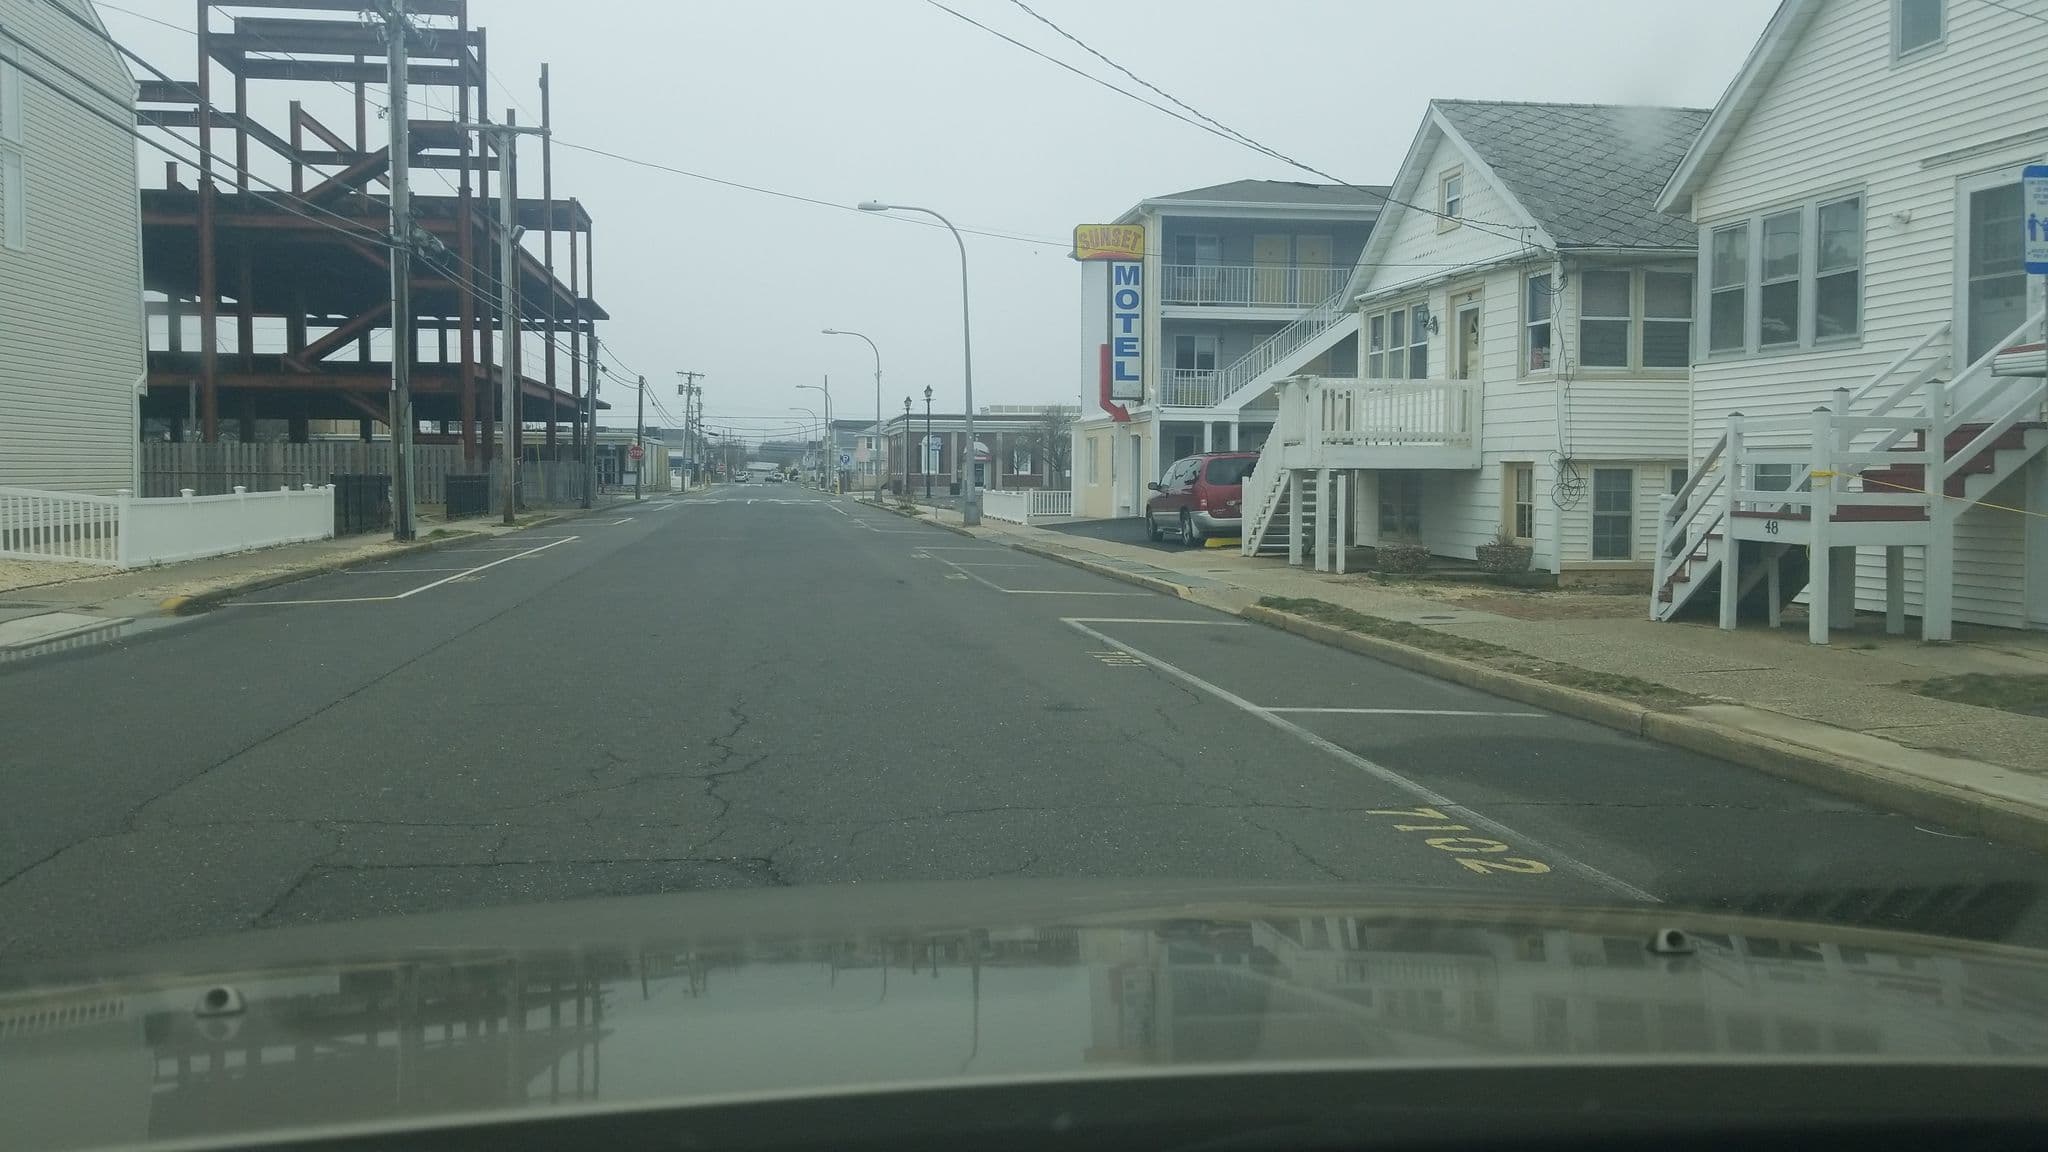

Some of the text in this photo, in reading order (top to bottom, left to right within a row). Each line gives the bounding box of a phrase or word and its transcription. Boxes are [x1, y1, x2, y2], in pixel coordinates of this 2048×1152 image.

[1079, 228, 1142, 251] SUNSET
[1115, 265, 1140, 381] MOTEL
[1765, 519, 1779, 535] 48
